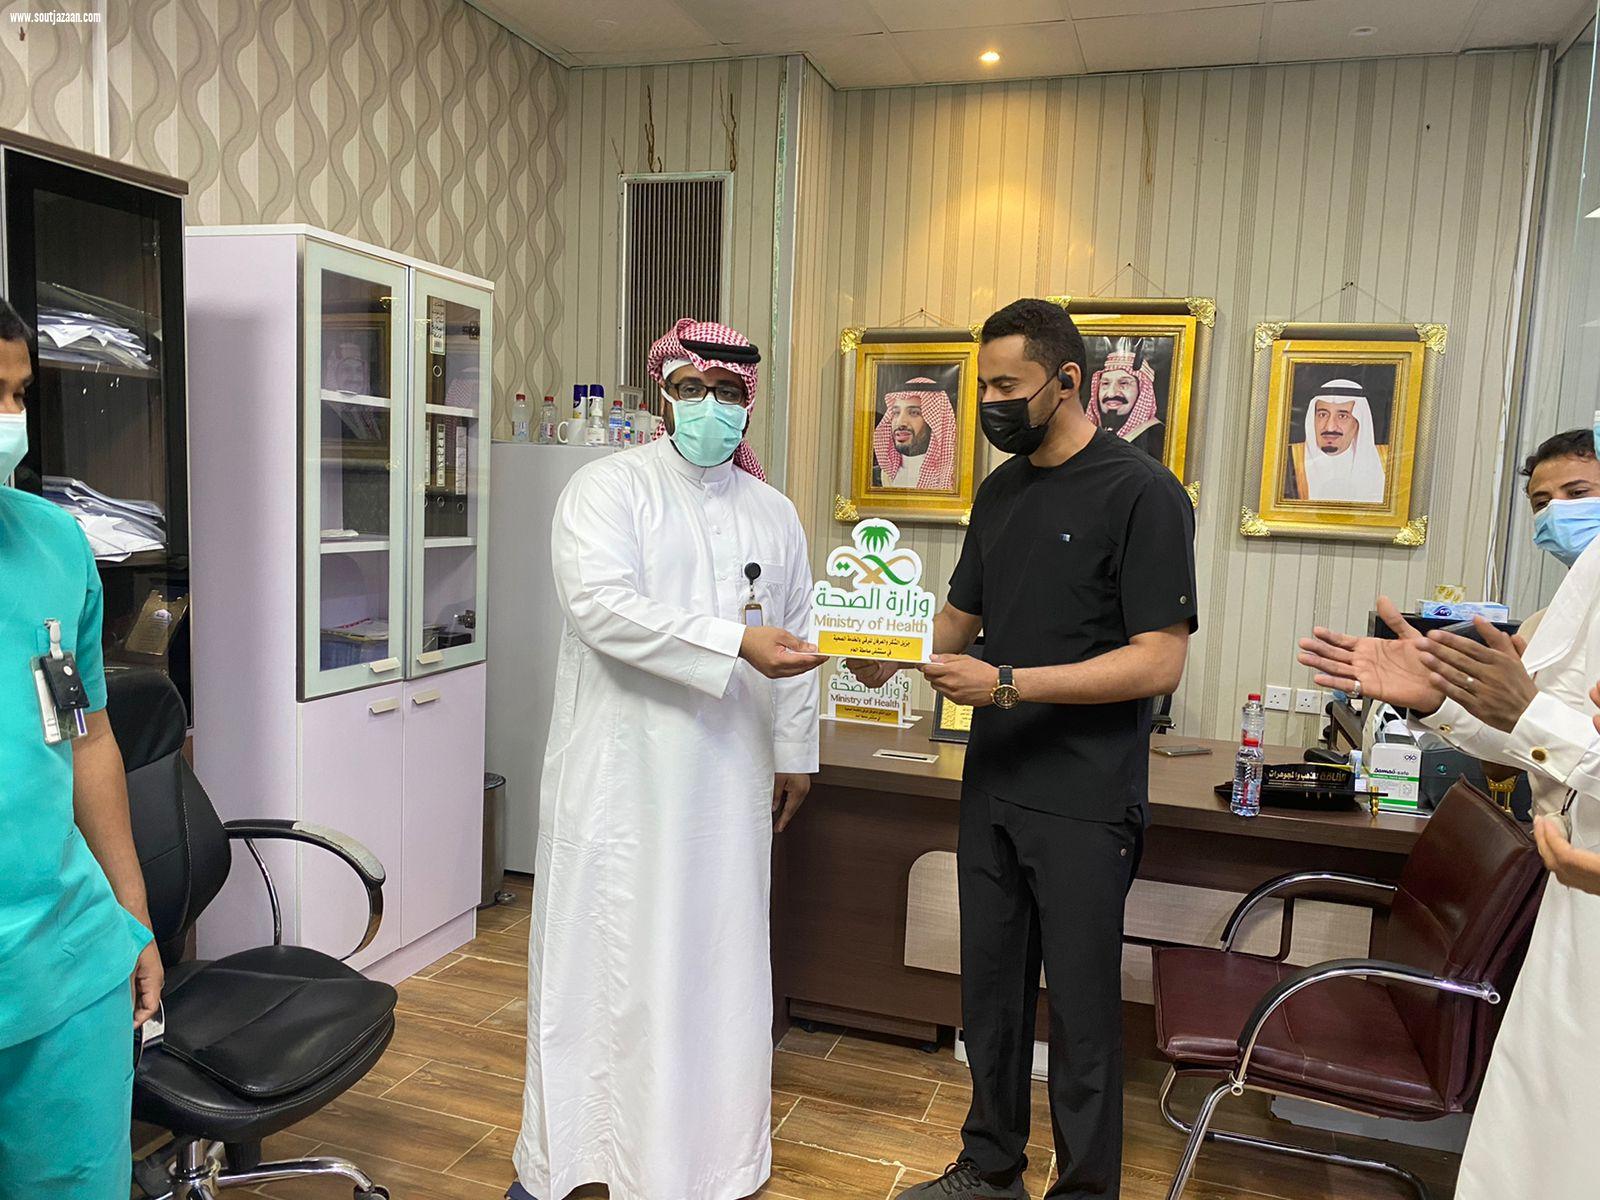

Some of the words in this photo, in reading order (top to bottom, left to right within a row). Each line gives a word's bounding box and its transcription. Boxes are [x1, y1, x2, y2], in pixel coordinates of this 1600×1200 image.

[816, 587, 880, 610] الصحة
[886, 590, 929, 617] وزارة
[814, 613, 864, 632] Ministry
[868, 617, 883, 630] of
[886, 618, 928, 633] Health
[830, 694, 861, 706] Ministry
[863, 697, 872, 705] of
[874, 699, 899, 708] Health
